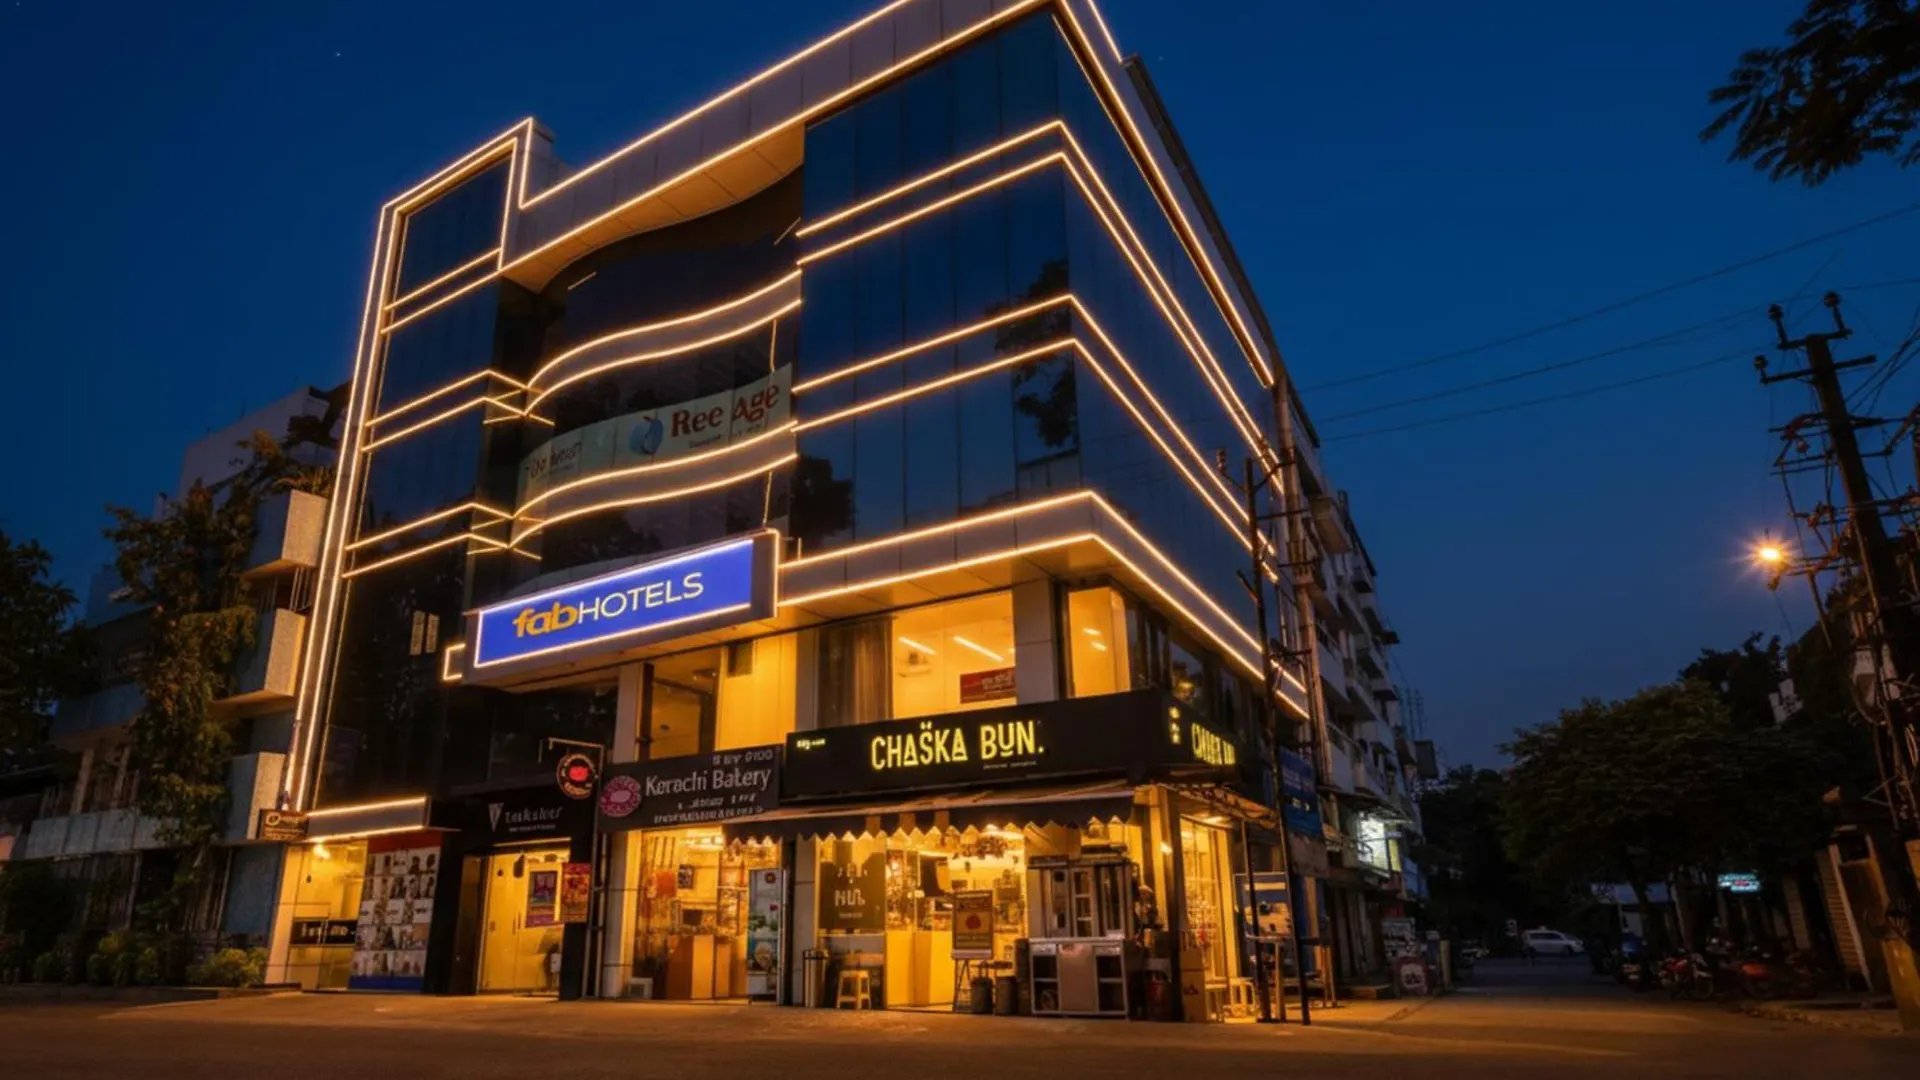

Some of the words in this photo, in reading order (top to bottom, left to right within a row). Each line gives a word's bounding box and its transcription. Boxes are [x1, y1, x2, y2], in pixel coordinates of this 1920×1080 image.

[670, 406, 725, 437] Ree
[733, 385, 779, 422] Age
[512, 573, 704, 638] fabHOTELS
